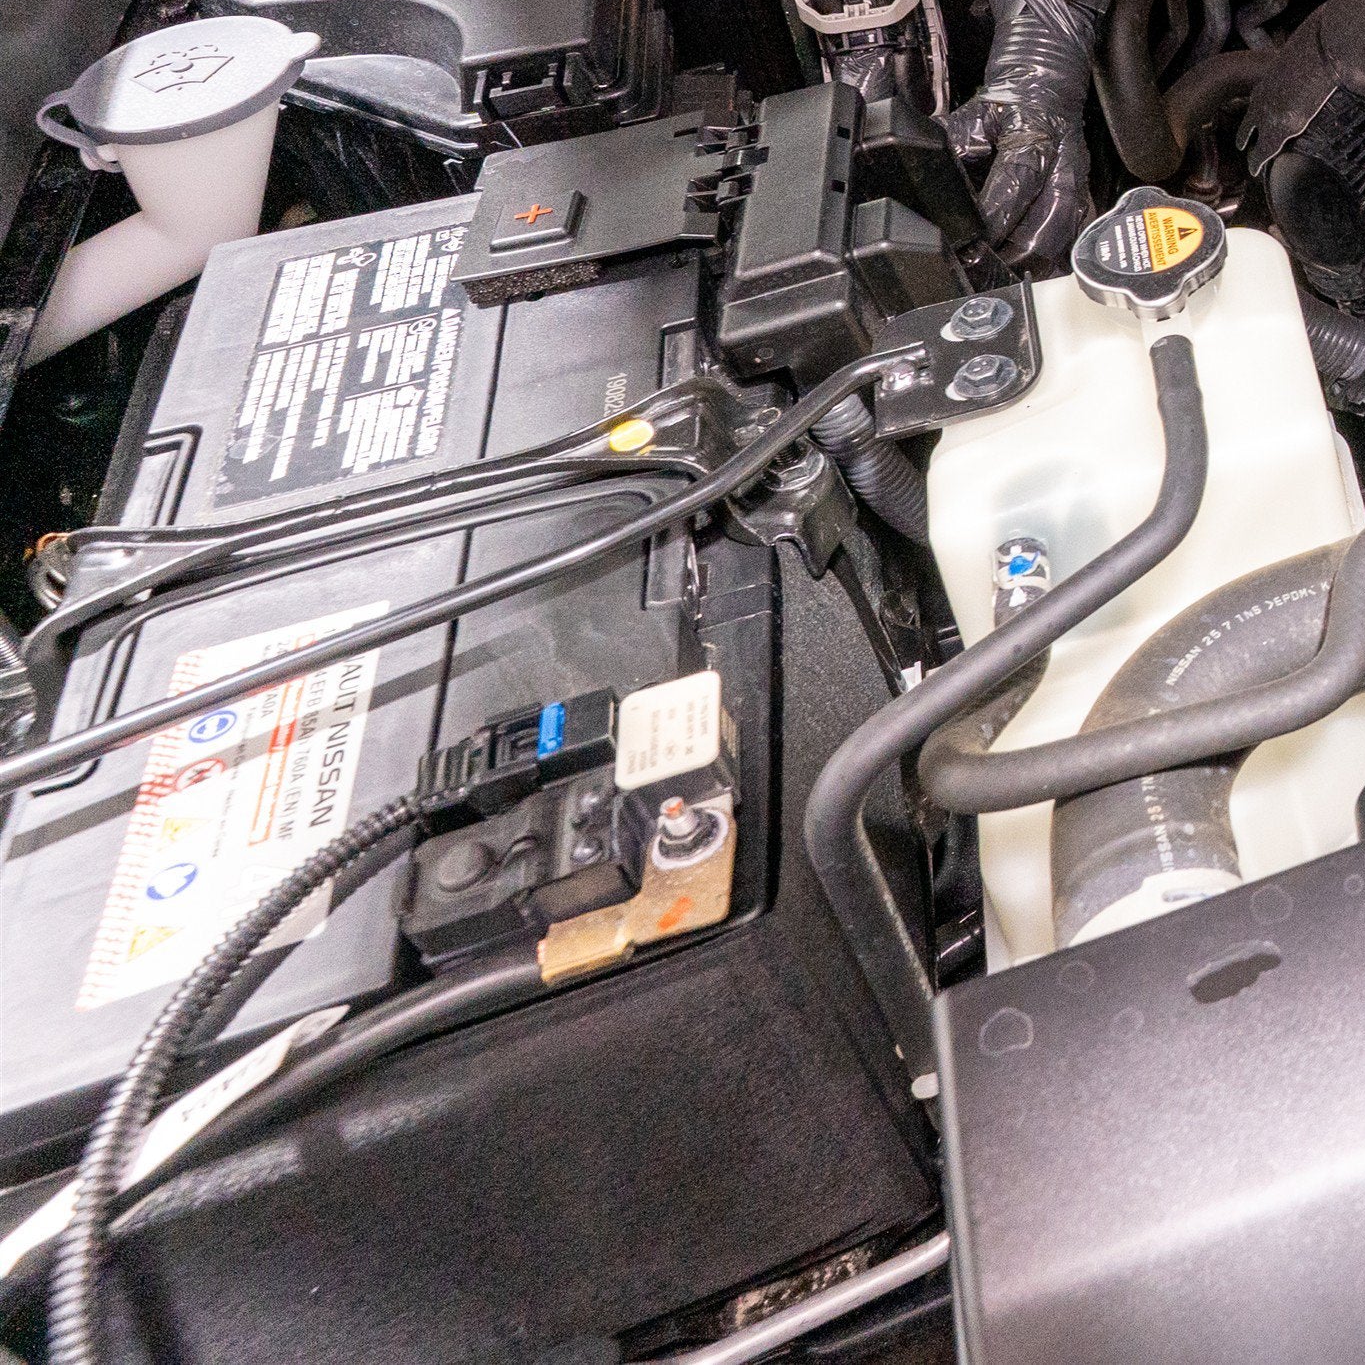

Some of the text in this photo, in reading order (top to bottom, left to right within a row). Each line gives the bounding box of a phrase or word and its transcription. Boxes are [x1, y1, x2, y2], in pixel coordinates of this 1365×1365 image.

[1148, 212, 1167, 266] AVERTISSEMENT
[1162, 216, 1179, 255] WARNING
[1165, 645, 1203, 686] NISSAN
[1201, 629, 1222, 646] 25
[308, 720, 351, 828] NISSAN
